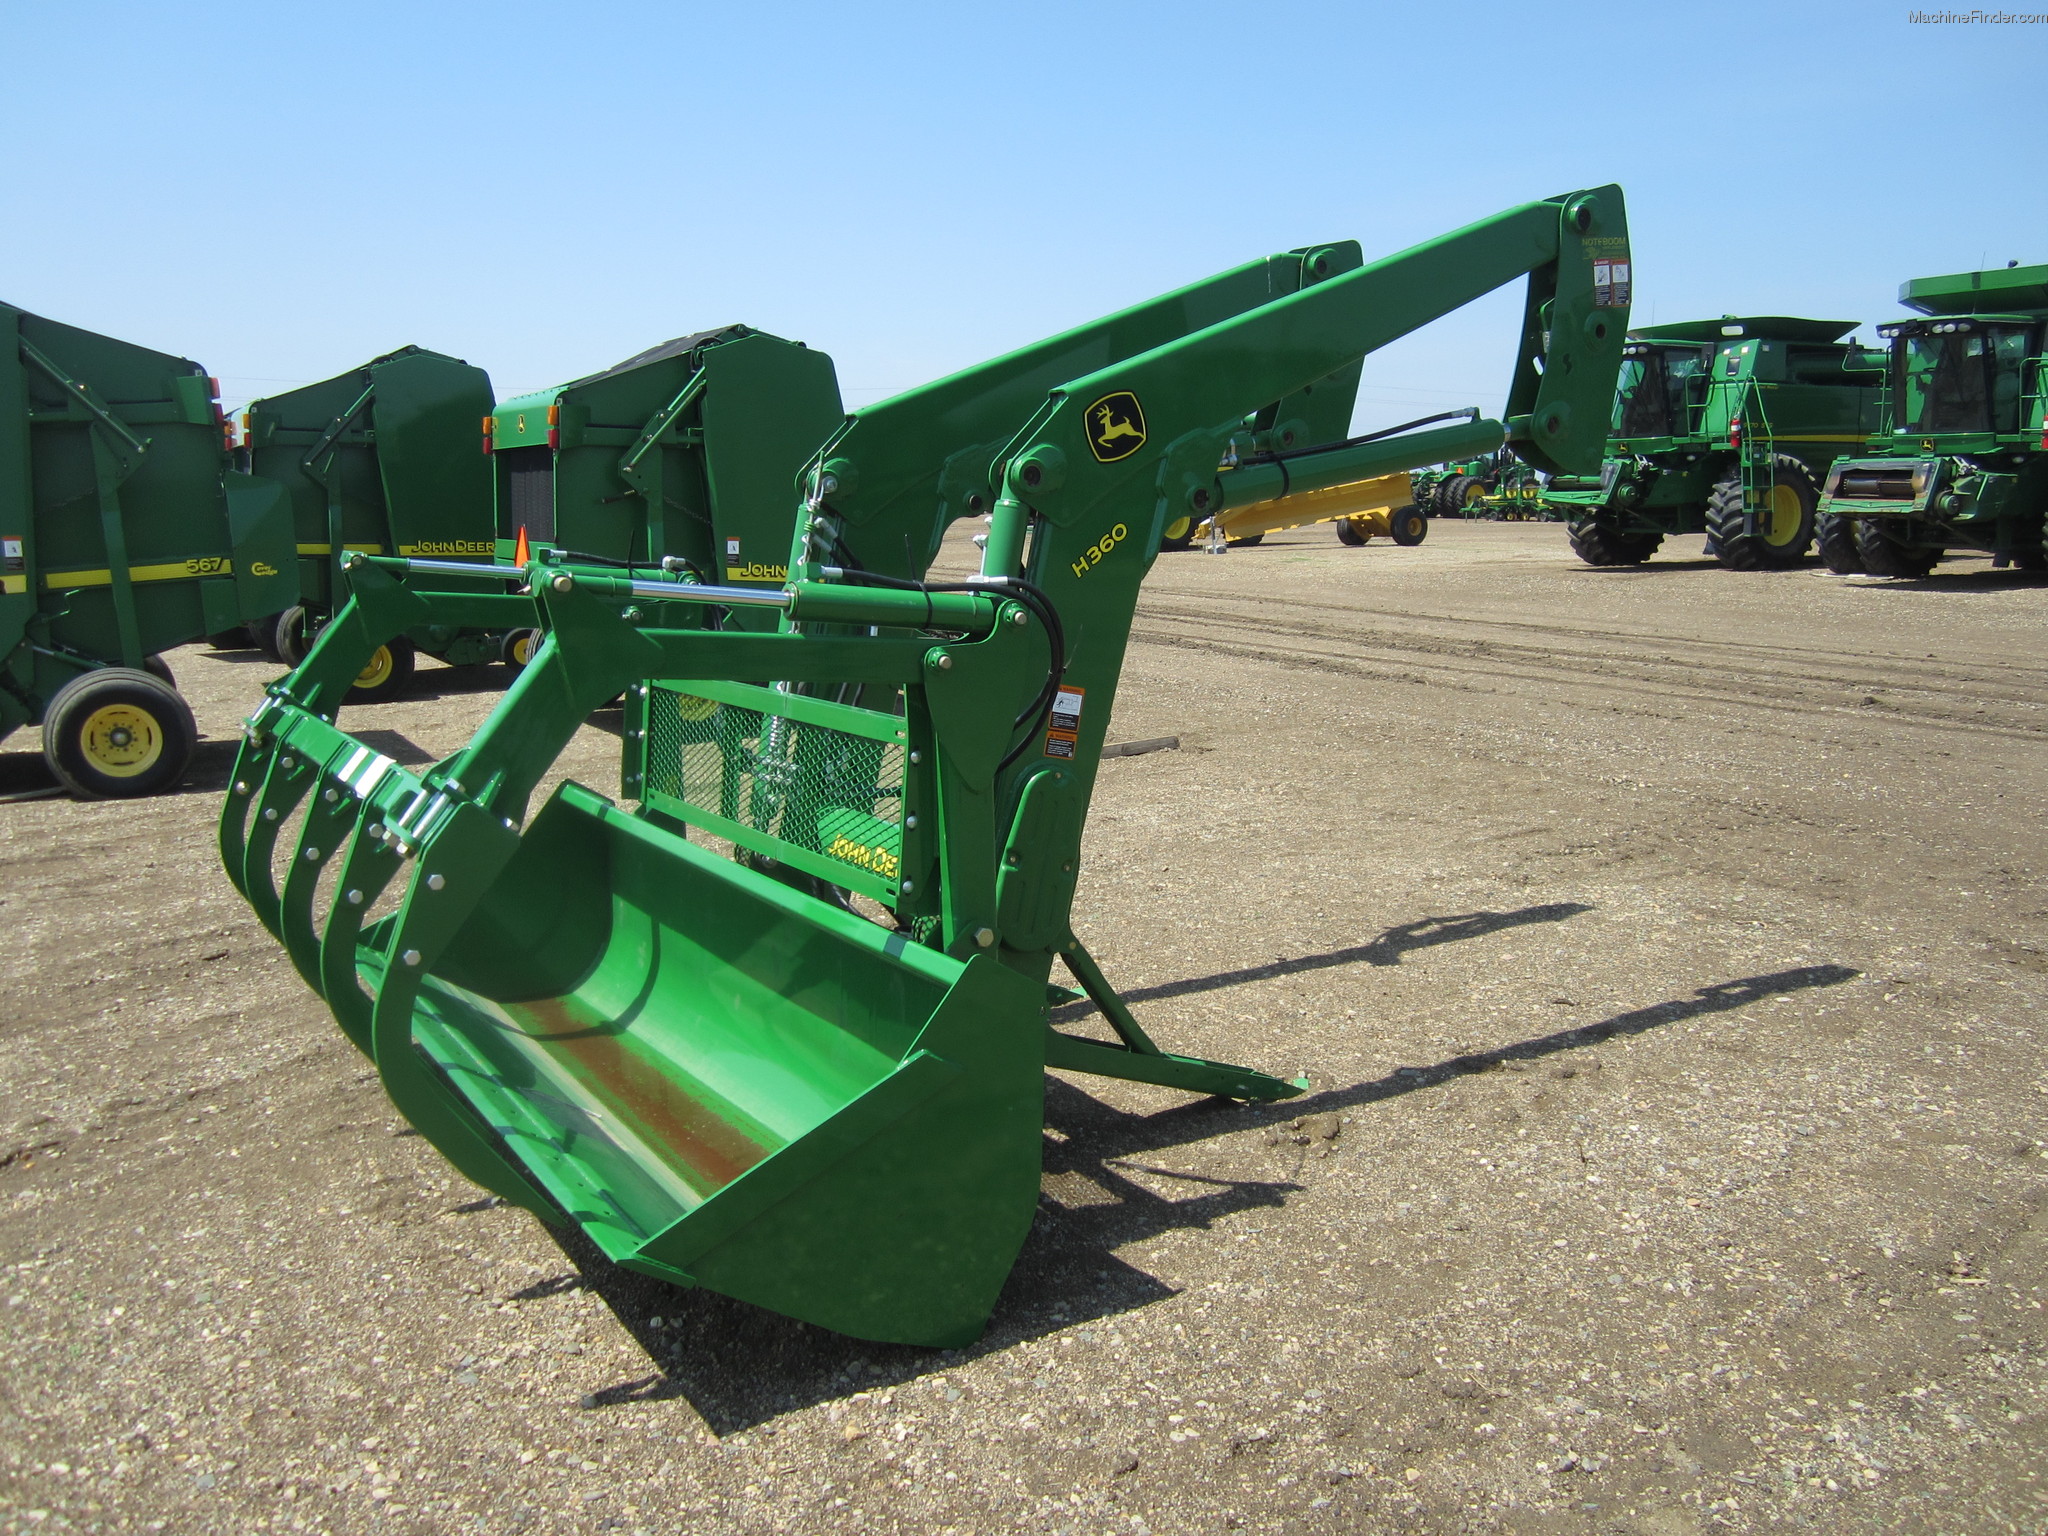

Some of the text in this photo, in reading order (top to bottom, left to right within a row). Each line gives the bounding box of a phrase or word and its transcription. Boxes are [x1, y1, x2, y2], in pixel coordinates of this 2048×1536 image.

[412, 540, 495, 552] JOHN DEER
[1071, 523, 1127, 578] H360
[186, 557, 221, 573] 567
[741, 561, 787, 577] JOHN
[828, 833, 898, 878] JOHN DE
